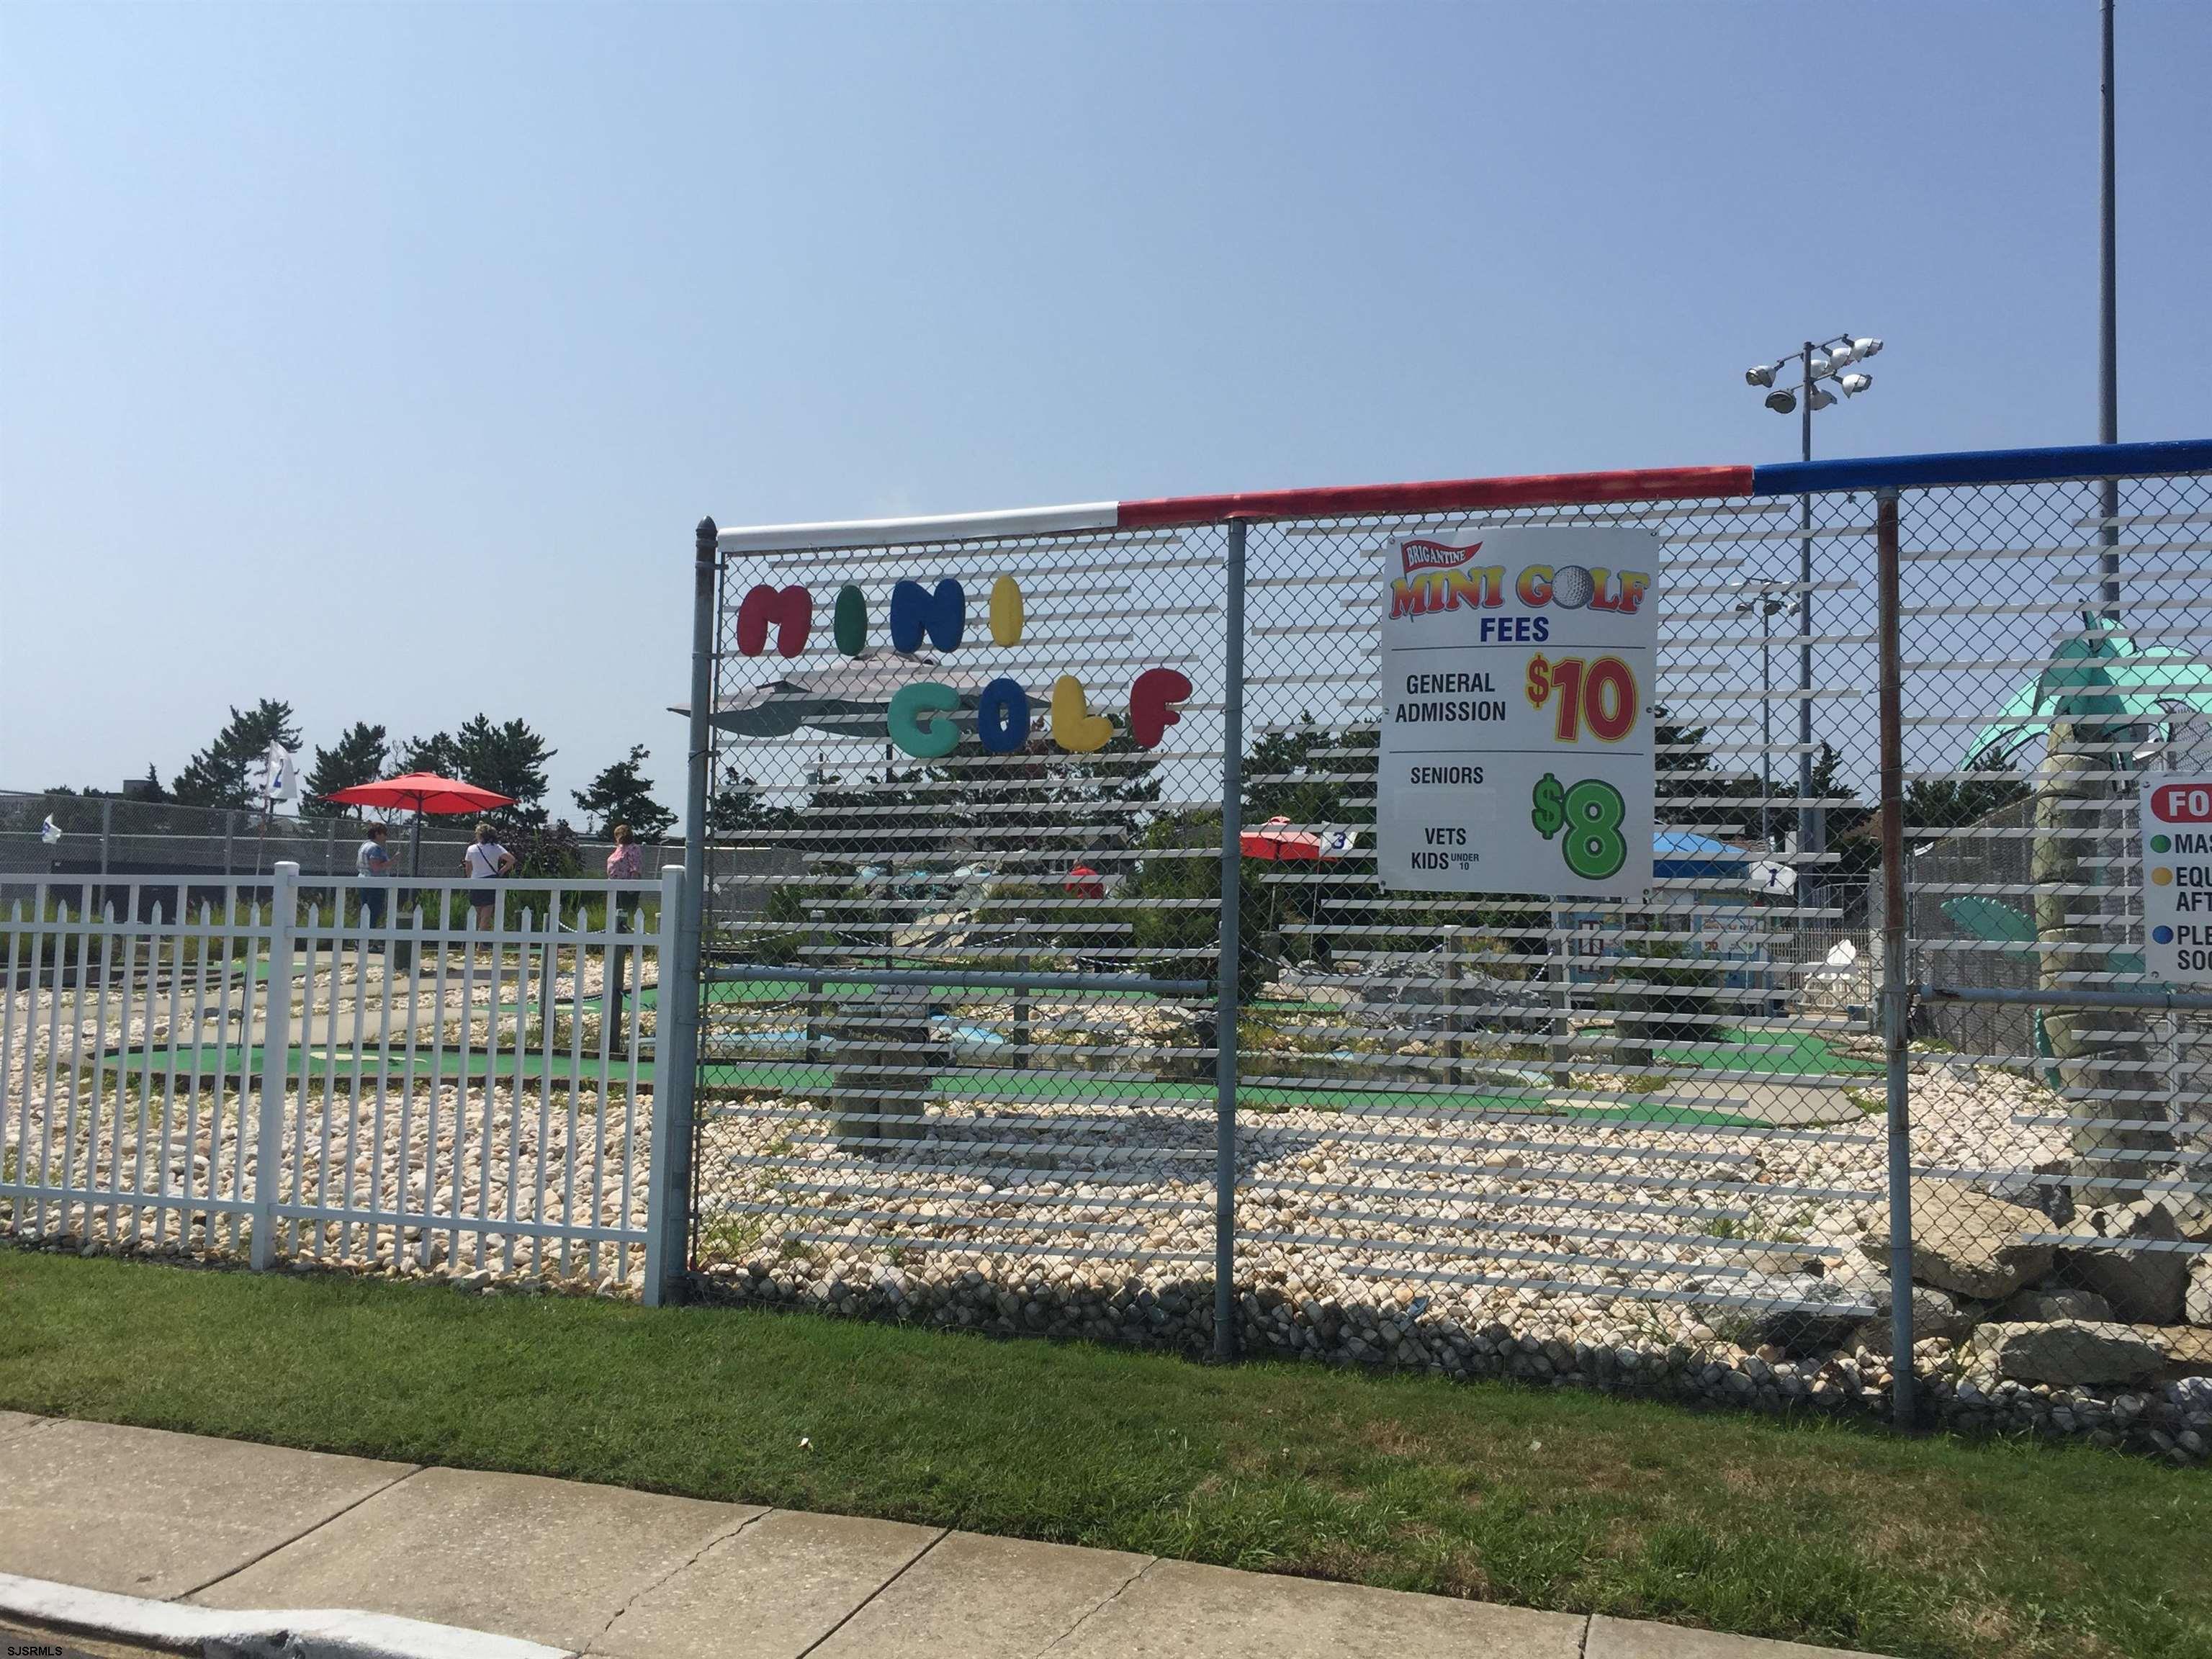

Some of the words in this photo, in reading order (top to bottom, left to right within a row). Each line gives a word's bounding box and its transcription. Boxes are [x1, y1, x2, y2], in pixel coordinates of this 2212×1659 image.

[1406, 545, 1465, 567] BRIGANTINE
[1389, 566, 1506, 619] MINI
[1516, 564, 1650, 615] GOLF
[737, 575, 1024, 658] MINI
[1480, 616, 1549, 642] FEES
[1406, 673, 1495, 694] GENERAL
[1526, 652, 1637, 743] $10
[887, 667, 1192, 757] GOLF
[1395, 701, 1506, 723] ADMISSION
[1411, 766, 1483, 784] SENIORS
[1425, 827, 1466, 845] VETS
[1532, 773, 1627, 880] $8
[1331, 831, 1347, 850] 3
[2175, 834, 2212, 854] MA
[1411, 852, 1449, 871] KIDS
[1451, 853, 1479, 862] UNDER
[1768, 868, 1778, 886] 1
